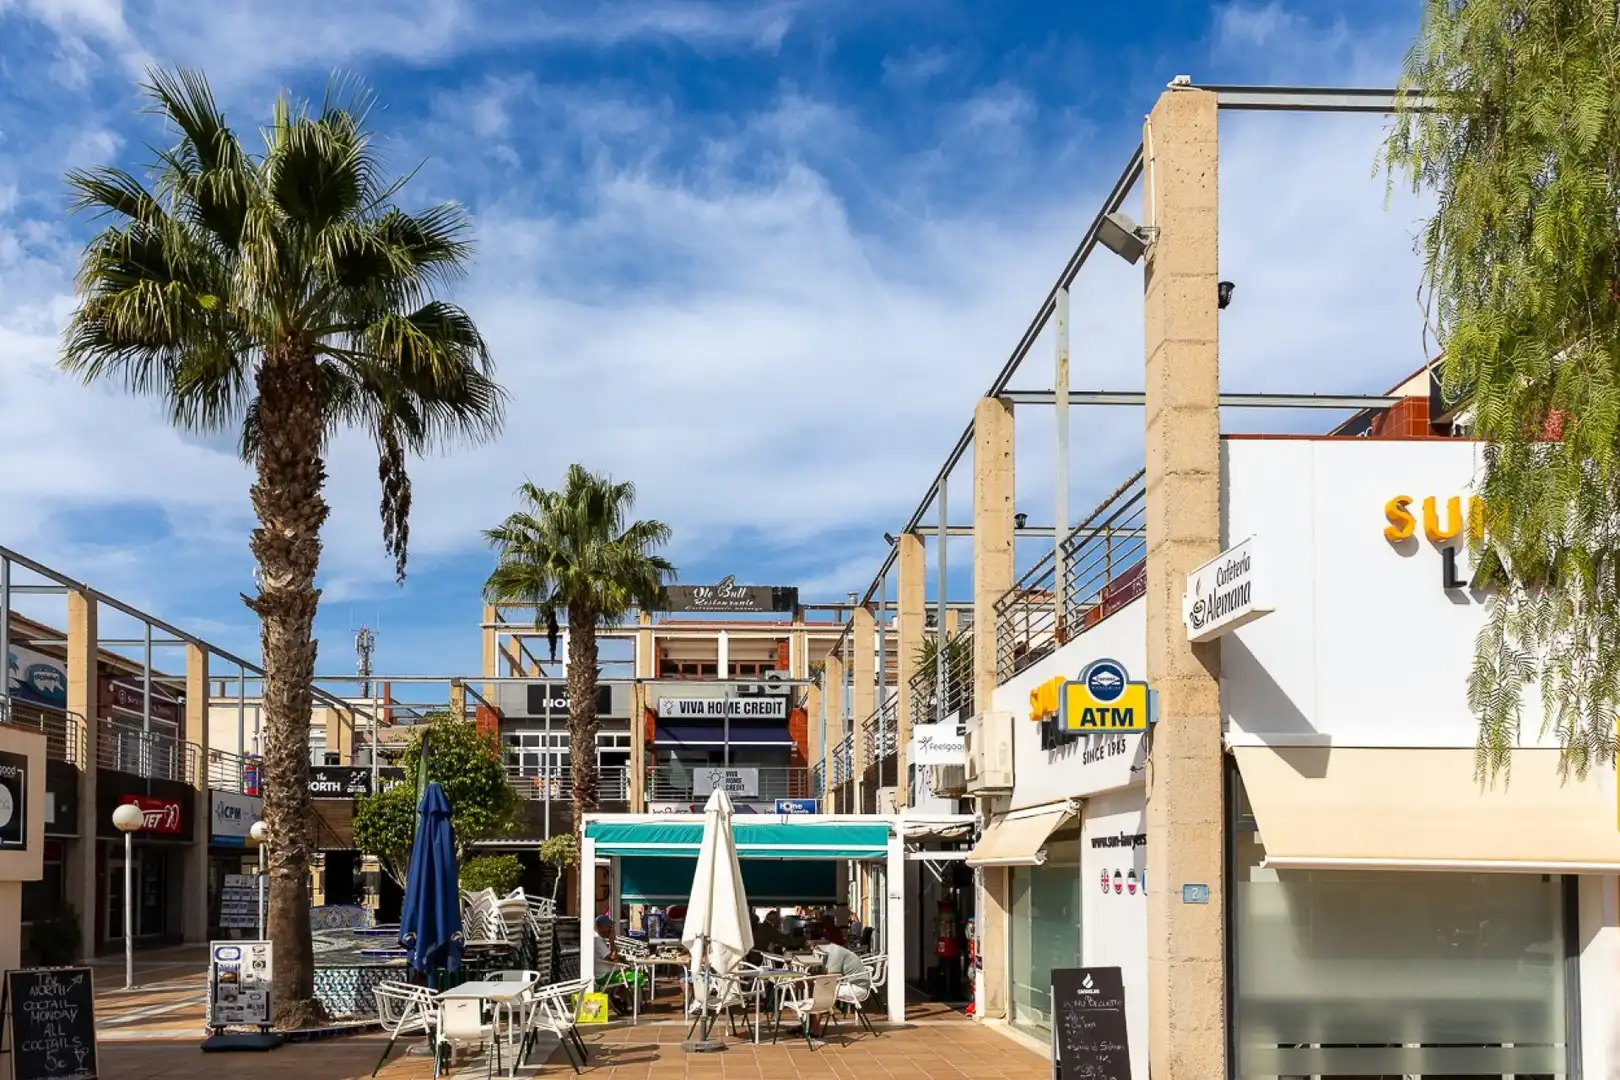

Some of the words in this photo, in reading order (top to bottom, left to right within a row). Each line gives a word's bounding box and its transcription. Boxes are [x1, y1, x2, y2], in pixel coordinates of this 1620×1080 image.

[1216, 551, 1251, 587] Cafetería
[718, 574, 747, 598] Bull
[1206, 581, 1251, 624] Alemana
[680, 701, 704, 714] VIVA
[707, 702, 740, 714] HOME
[744, 702, 783, 715] CREDIT
[1080, 708, 1134, 726] ATM
[1083, 745, 1104, 765] SINCE
[1107, 739, 1126, 757] 1985
[225, 806, 241, 819] CPM
[1192, 888, 1200, 899] 2
[30, 1008, 78, 1025] MONDAY
[44, 1022, 66, 1037] ALL
